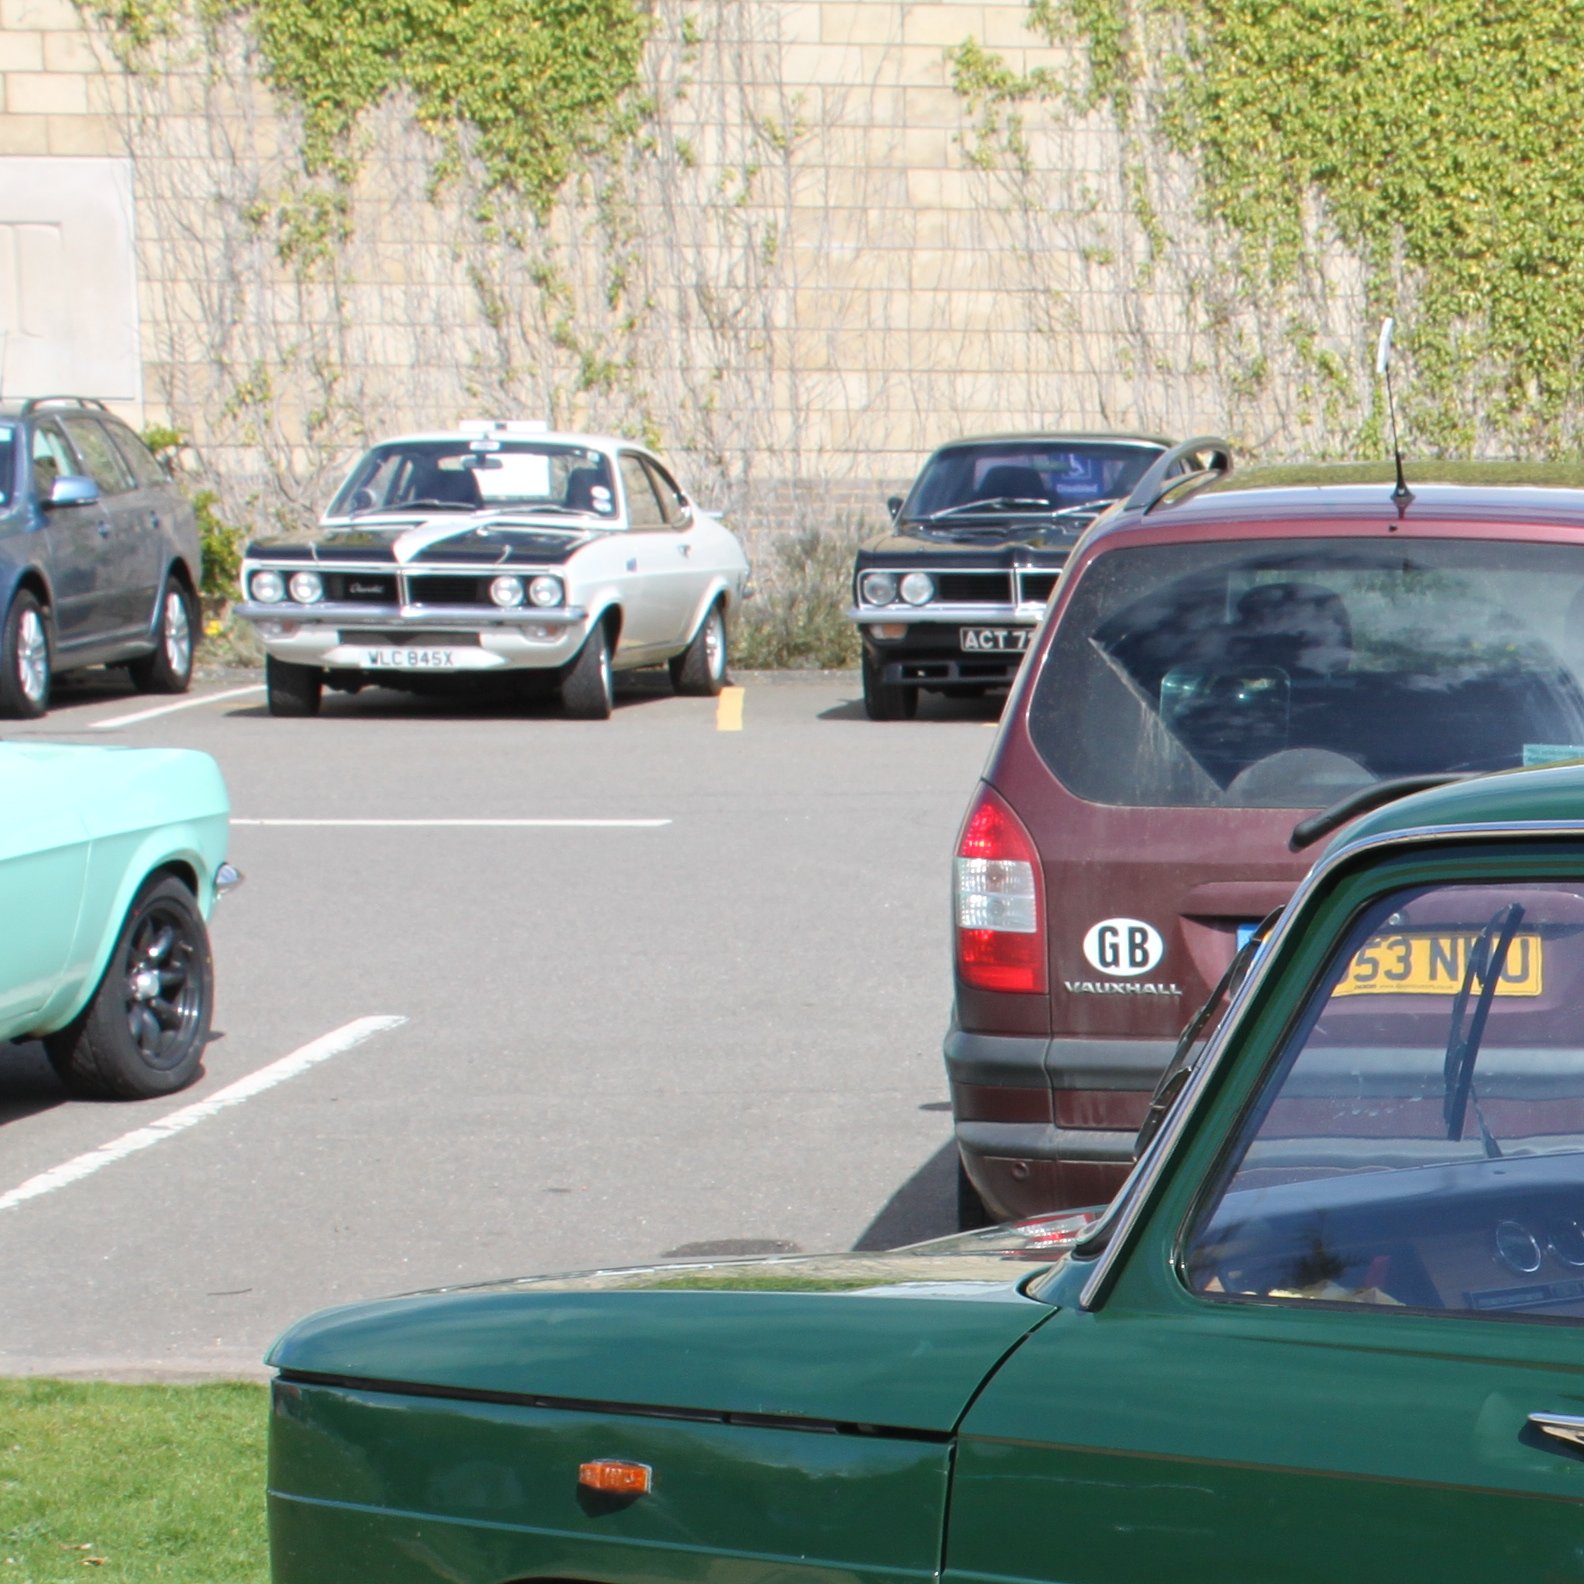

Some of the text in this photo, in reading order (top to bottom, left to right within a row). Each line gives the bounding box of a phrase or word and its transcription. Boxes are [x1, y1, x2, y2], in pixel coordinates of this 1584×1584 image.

[964, 629, 1008, 650] ACT
[367, 651, 454, 667] WLC 845X
[1097, 924, 1151, 969] GB
[1338, 935, 1531, 985] 53 NU
[1063, 980, 1184, 996] VAUXHALL
